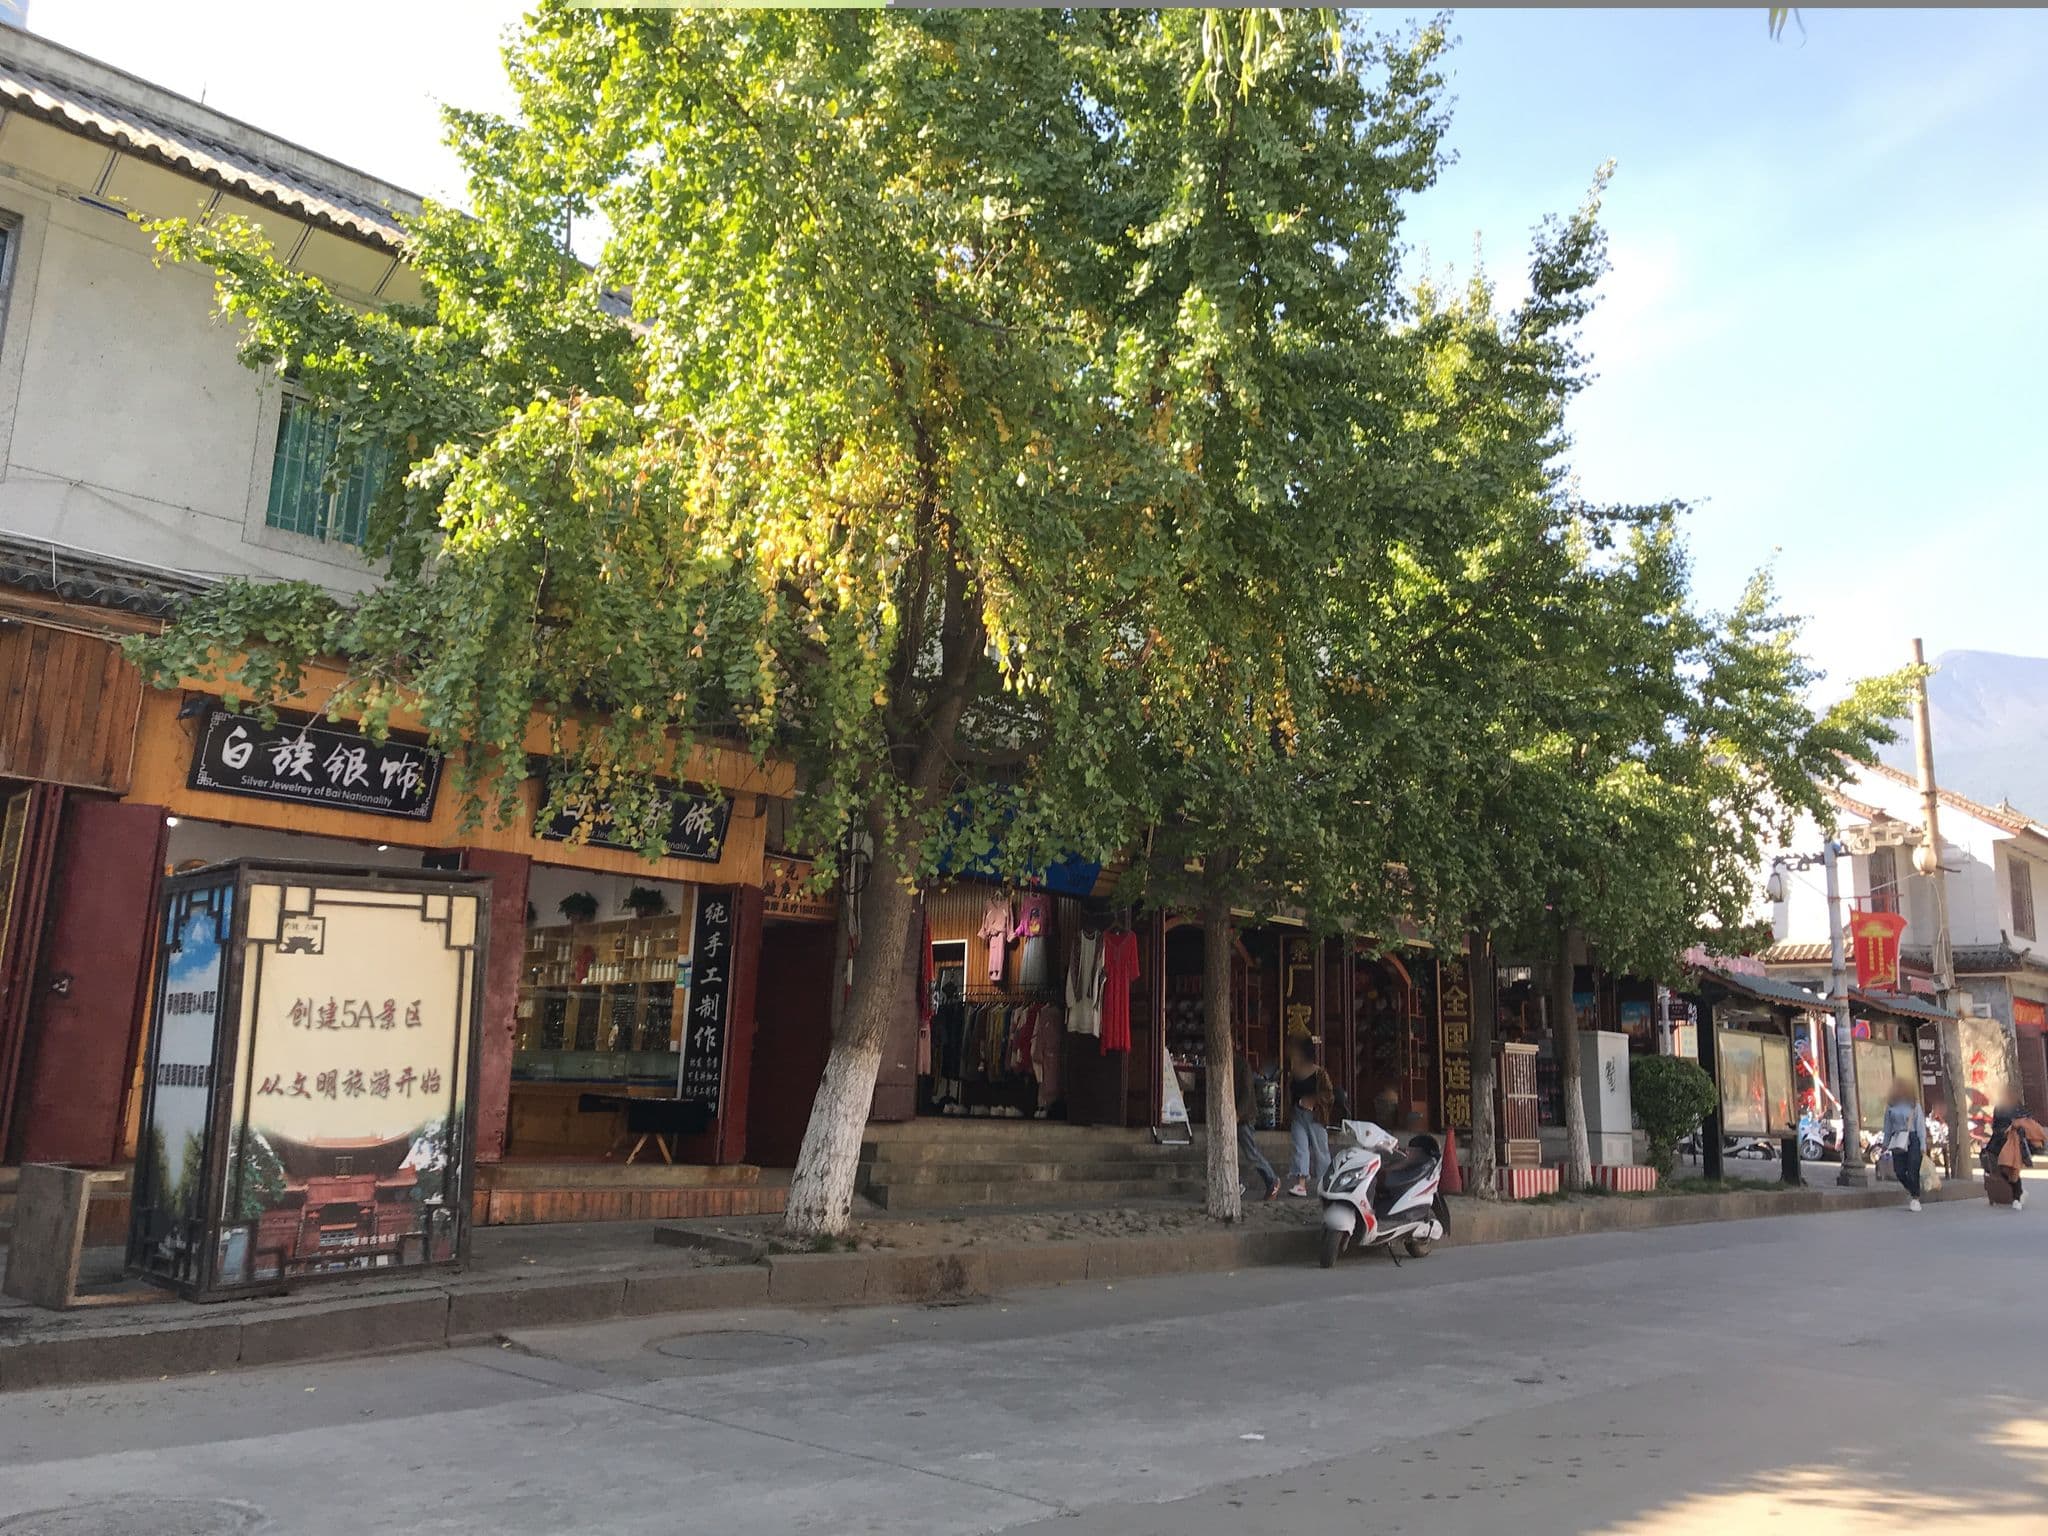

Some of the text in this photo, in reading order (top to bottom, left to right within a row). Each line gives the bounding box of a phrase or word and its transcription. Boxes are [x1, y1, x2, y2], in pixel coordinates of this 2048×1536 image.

[222, 725, 418, 799] 白族银饰
[241, 775, 268, 787] Silver
[314, 786, 325, 796] of
[325, 788, 341, 798] Bai
[342, 791, 393, 807] Nationality
[694, 902, 729, 1053] 纯手工制作
[287, 996, 423, 1030] 创建5A景区
[256, 1066, 442, 1100] 从文明旅游开始
